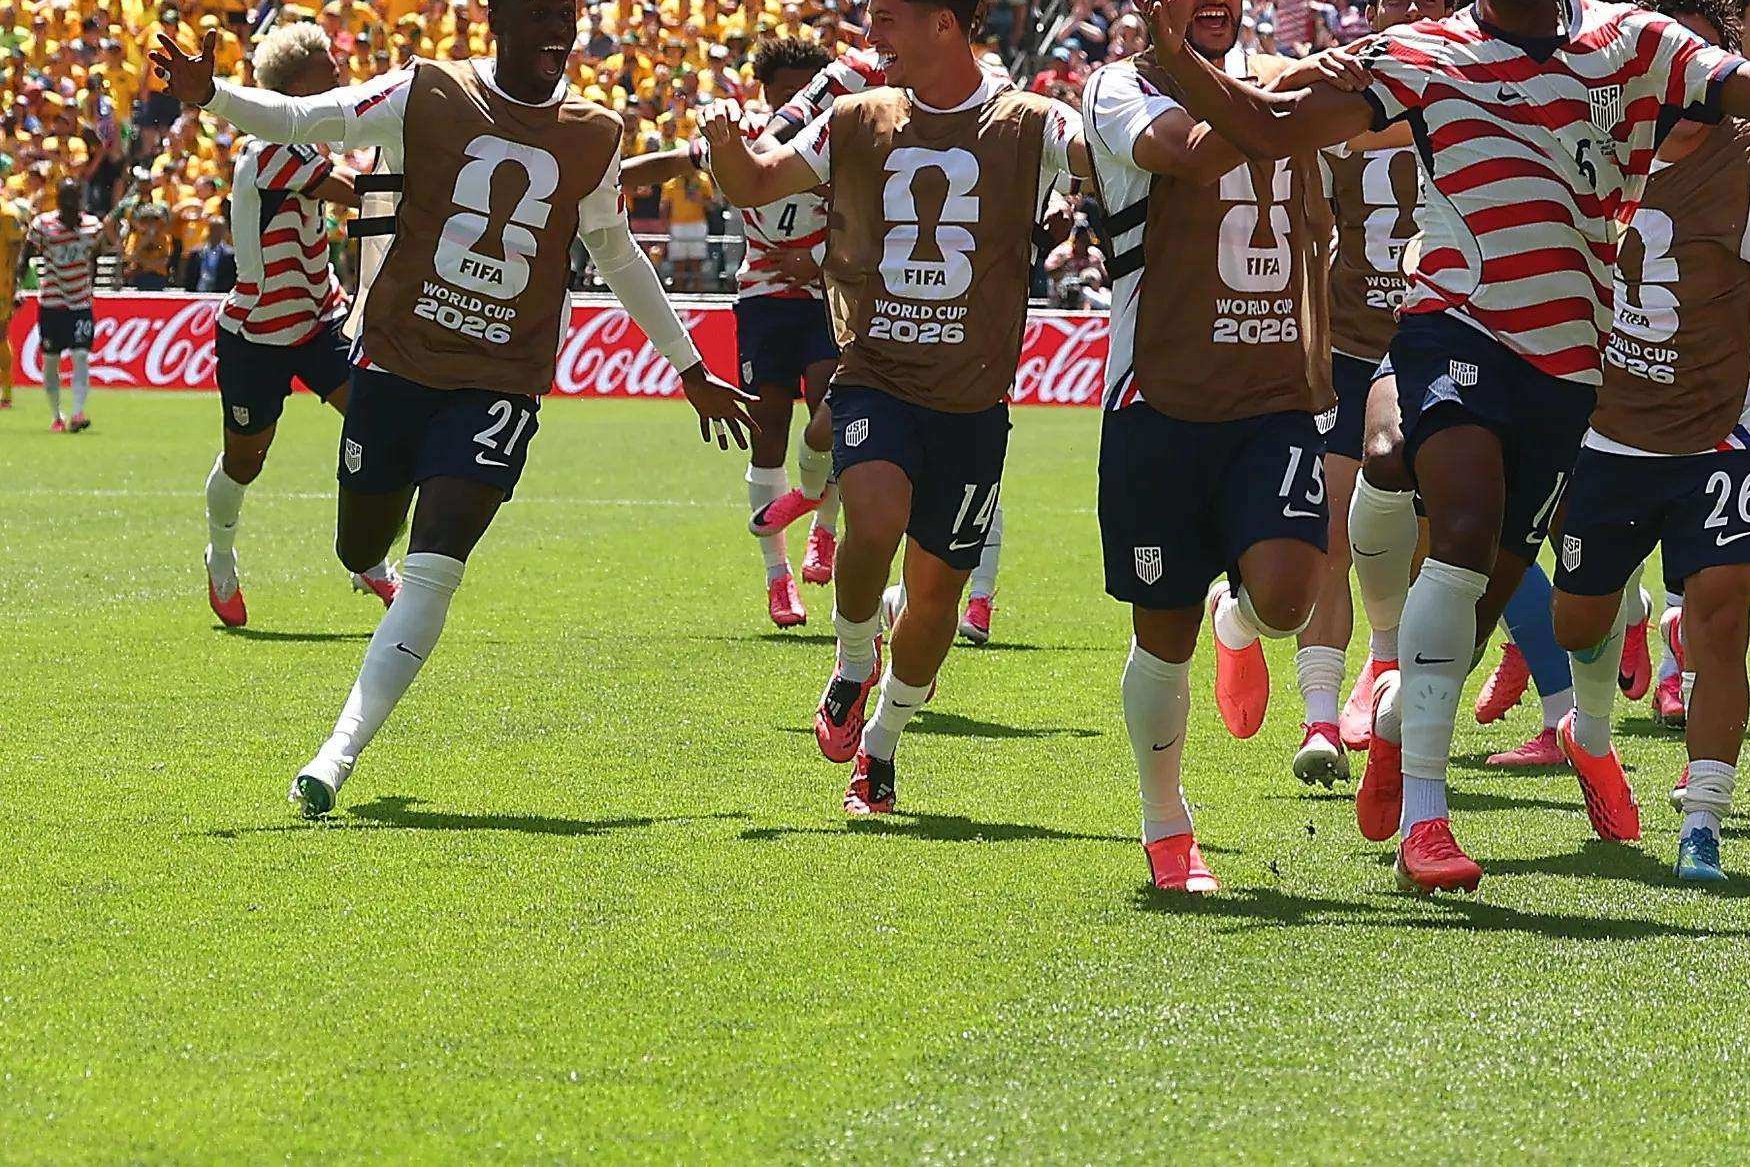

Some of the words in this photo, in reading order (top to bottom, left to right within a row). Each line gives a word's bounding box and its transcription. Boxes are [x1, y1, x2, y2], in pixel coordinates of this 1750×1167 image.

[777, 202, 797, 236] 4
[459, 258, 504, 285] FIFA
[904, 269, 947, 286] FIFA
[1246, 257, 1280, 275] FIFA
[422, 281, 482, 312] WORLD
[484, 304, 516, 321] CUP
[875, 299, 932, 320] WORLD
[936, 306, 968, 320] CUP
[1216, 298, 1270, 316] WORLD
[1273, 298, 1293, 315] CUP
[1366, 289, 1405, 308] 20
[414, 297, 511, 344] 2026
[868, 317, 964, 344] 2026
[1213, 317, 1298, 344] 2026
[1620, 308, 1650, 329] FIFA
[1608, 333, 1641, 357] ORLD
[1643, 347, 1678, 364] CUP
[1604, 345, 1675, 384] 026
[473, 400, 530, 457] 21
[952, 482, 999, 535] 14
